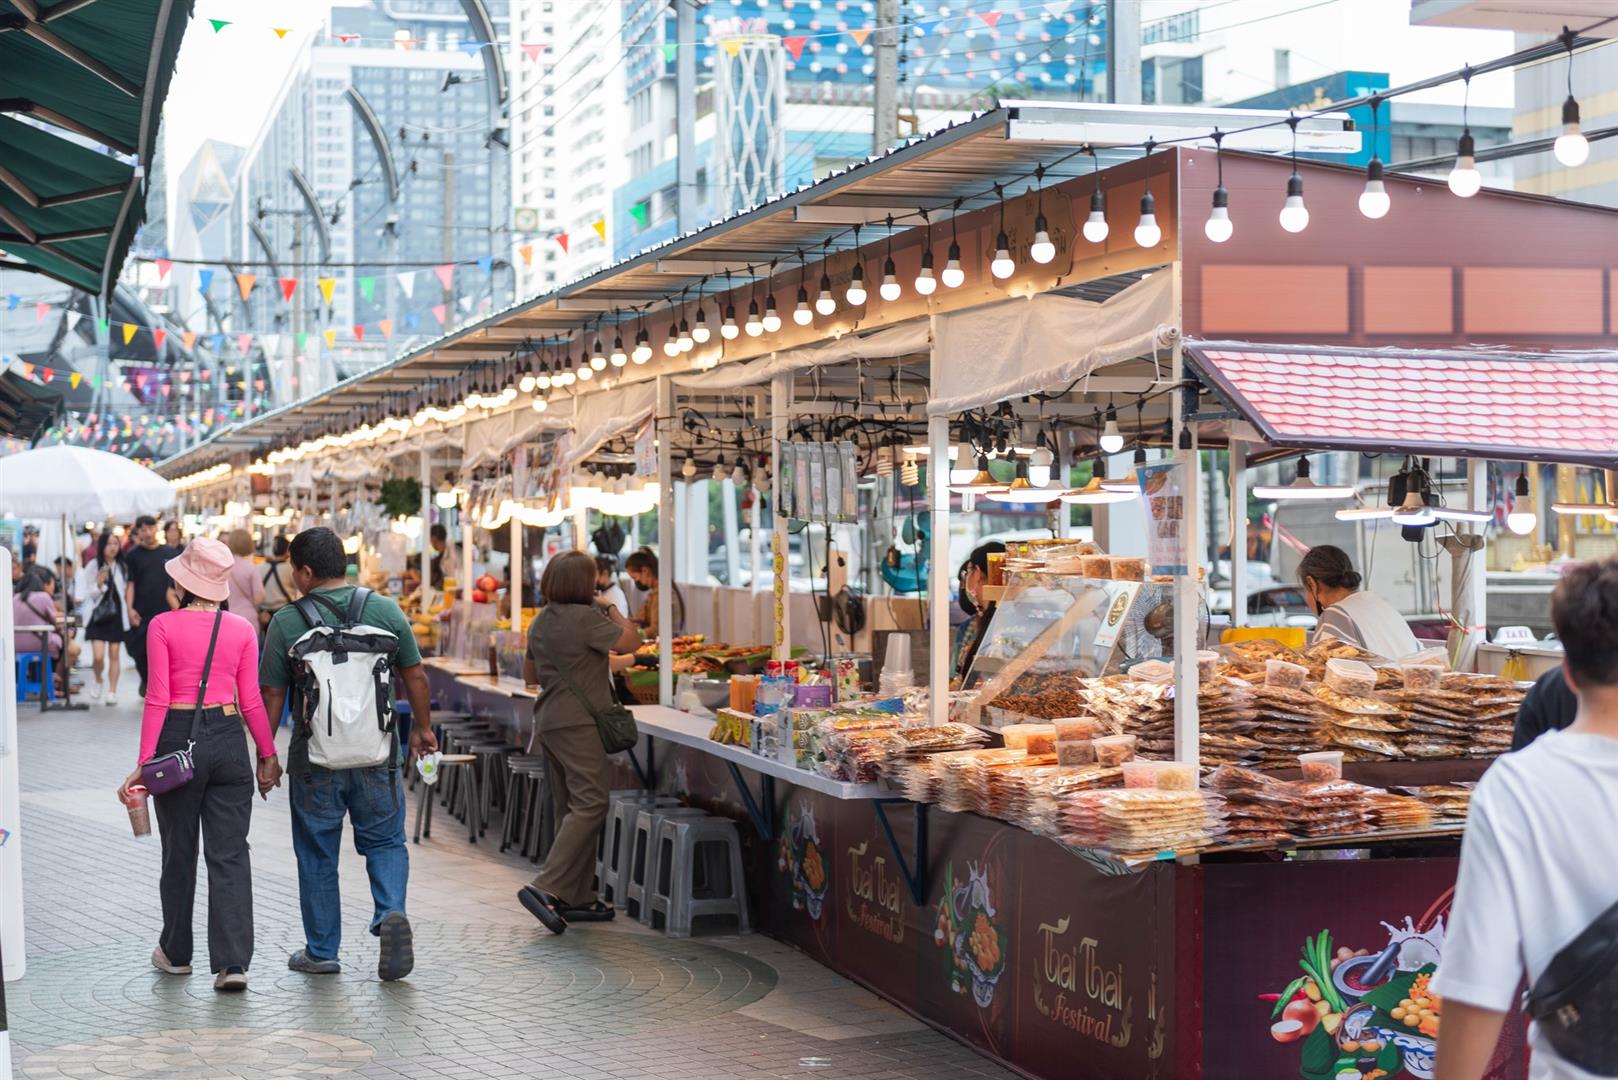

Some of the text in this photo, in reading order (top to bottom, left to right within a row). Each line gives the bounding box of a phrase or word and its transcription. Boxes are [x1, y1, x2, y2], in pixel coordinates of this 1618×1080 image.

[847, 840, 901, 914] Thai Thai
[1038, 914, 1076, 993] Thai
[1080, 936, 1123, 1011] Thai
[1051, 992, 1113, 1044] Festival
